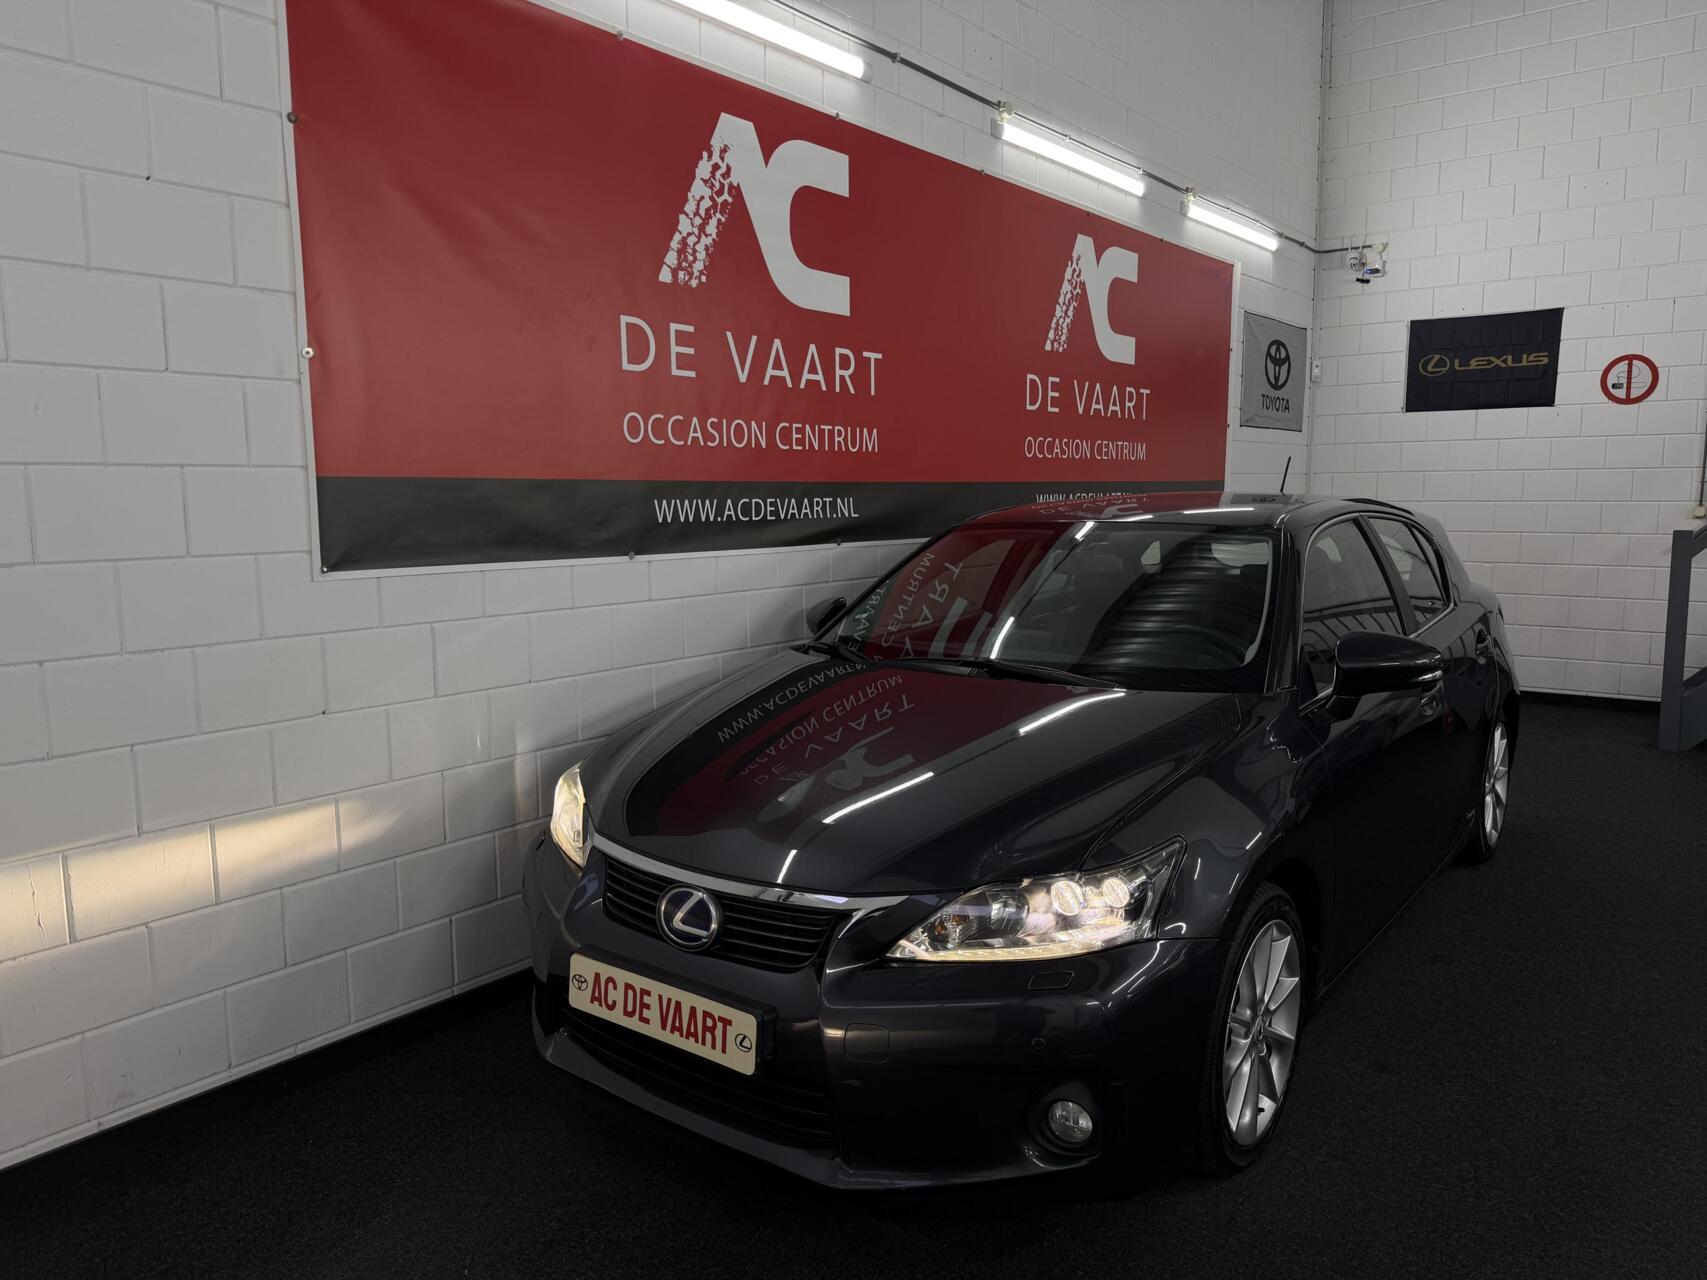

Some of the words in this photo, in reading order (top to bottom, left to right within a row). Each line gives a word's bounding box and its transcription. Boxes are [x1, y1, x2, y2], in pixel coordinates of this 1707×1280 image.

[658, 112, 850, 317] AC
[1044, 233, 1139, 365] AC
[620, 314, 697, 379] DE
[725, 330, 883, 396] VAART
[1454, 352, 1549, 371] LEXUS
[1026, 374, 1061, 413] DE
[1073, 379, 1151, 420] VAART
[1261, 394, 1290, 414] TOYOTA
[623, 411, 767, 448] OCCASION
[776, 422, 879, 453] CENTRUM
[1025, 436, 1091, 460] OCCASION
[1094, 440, 1146, 461] CENTRUM
[654, 497, 860, 523] WWW.ACDEVAART.NL
[590, 972, 618, 1012] AC
[622, 982, 652, 1025] DE
[658, 993, 733, 1055] VAART
